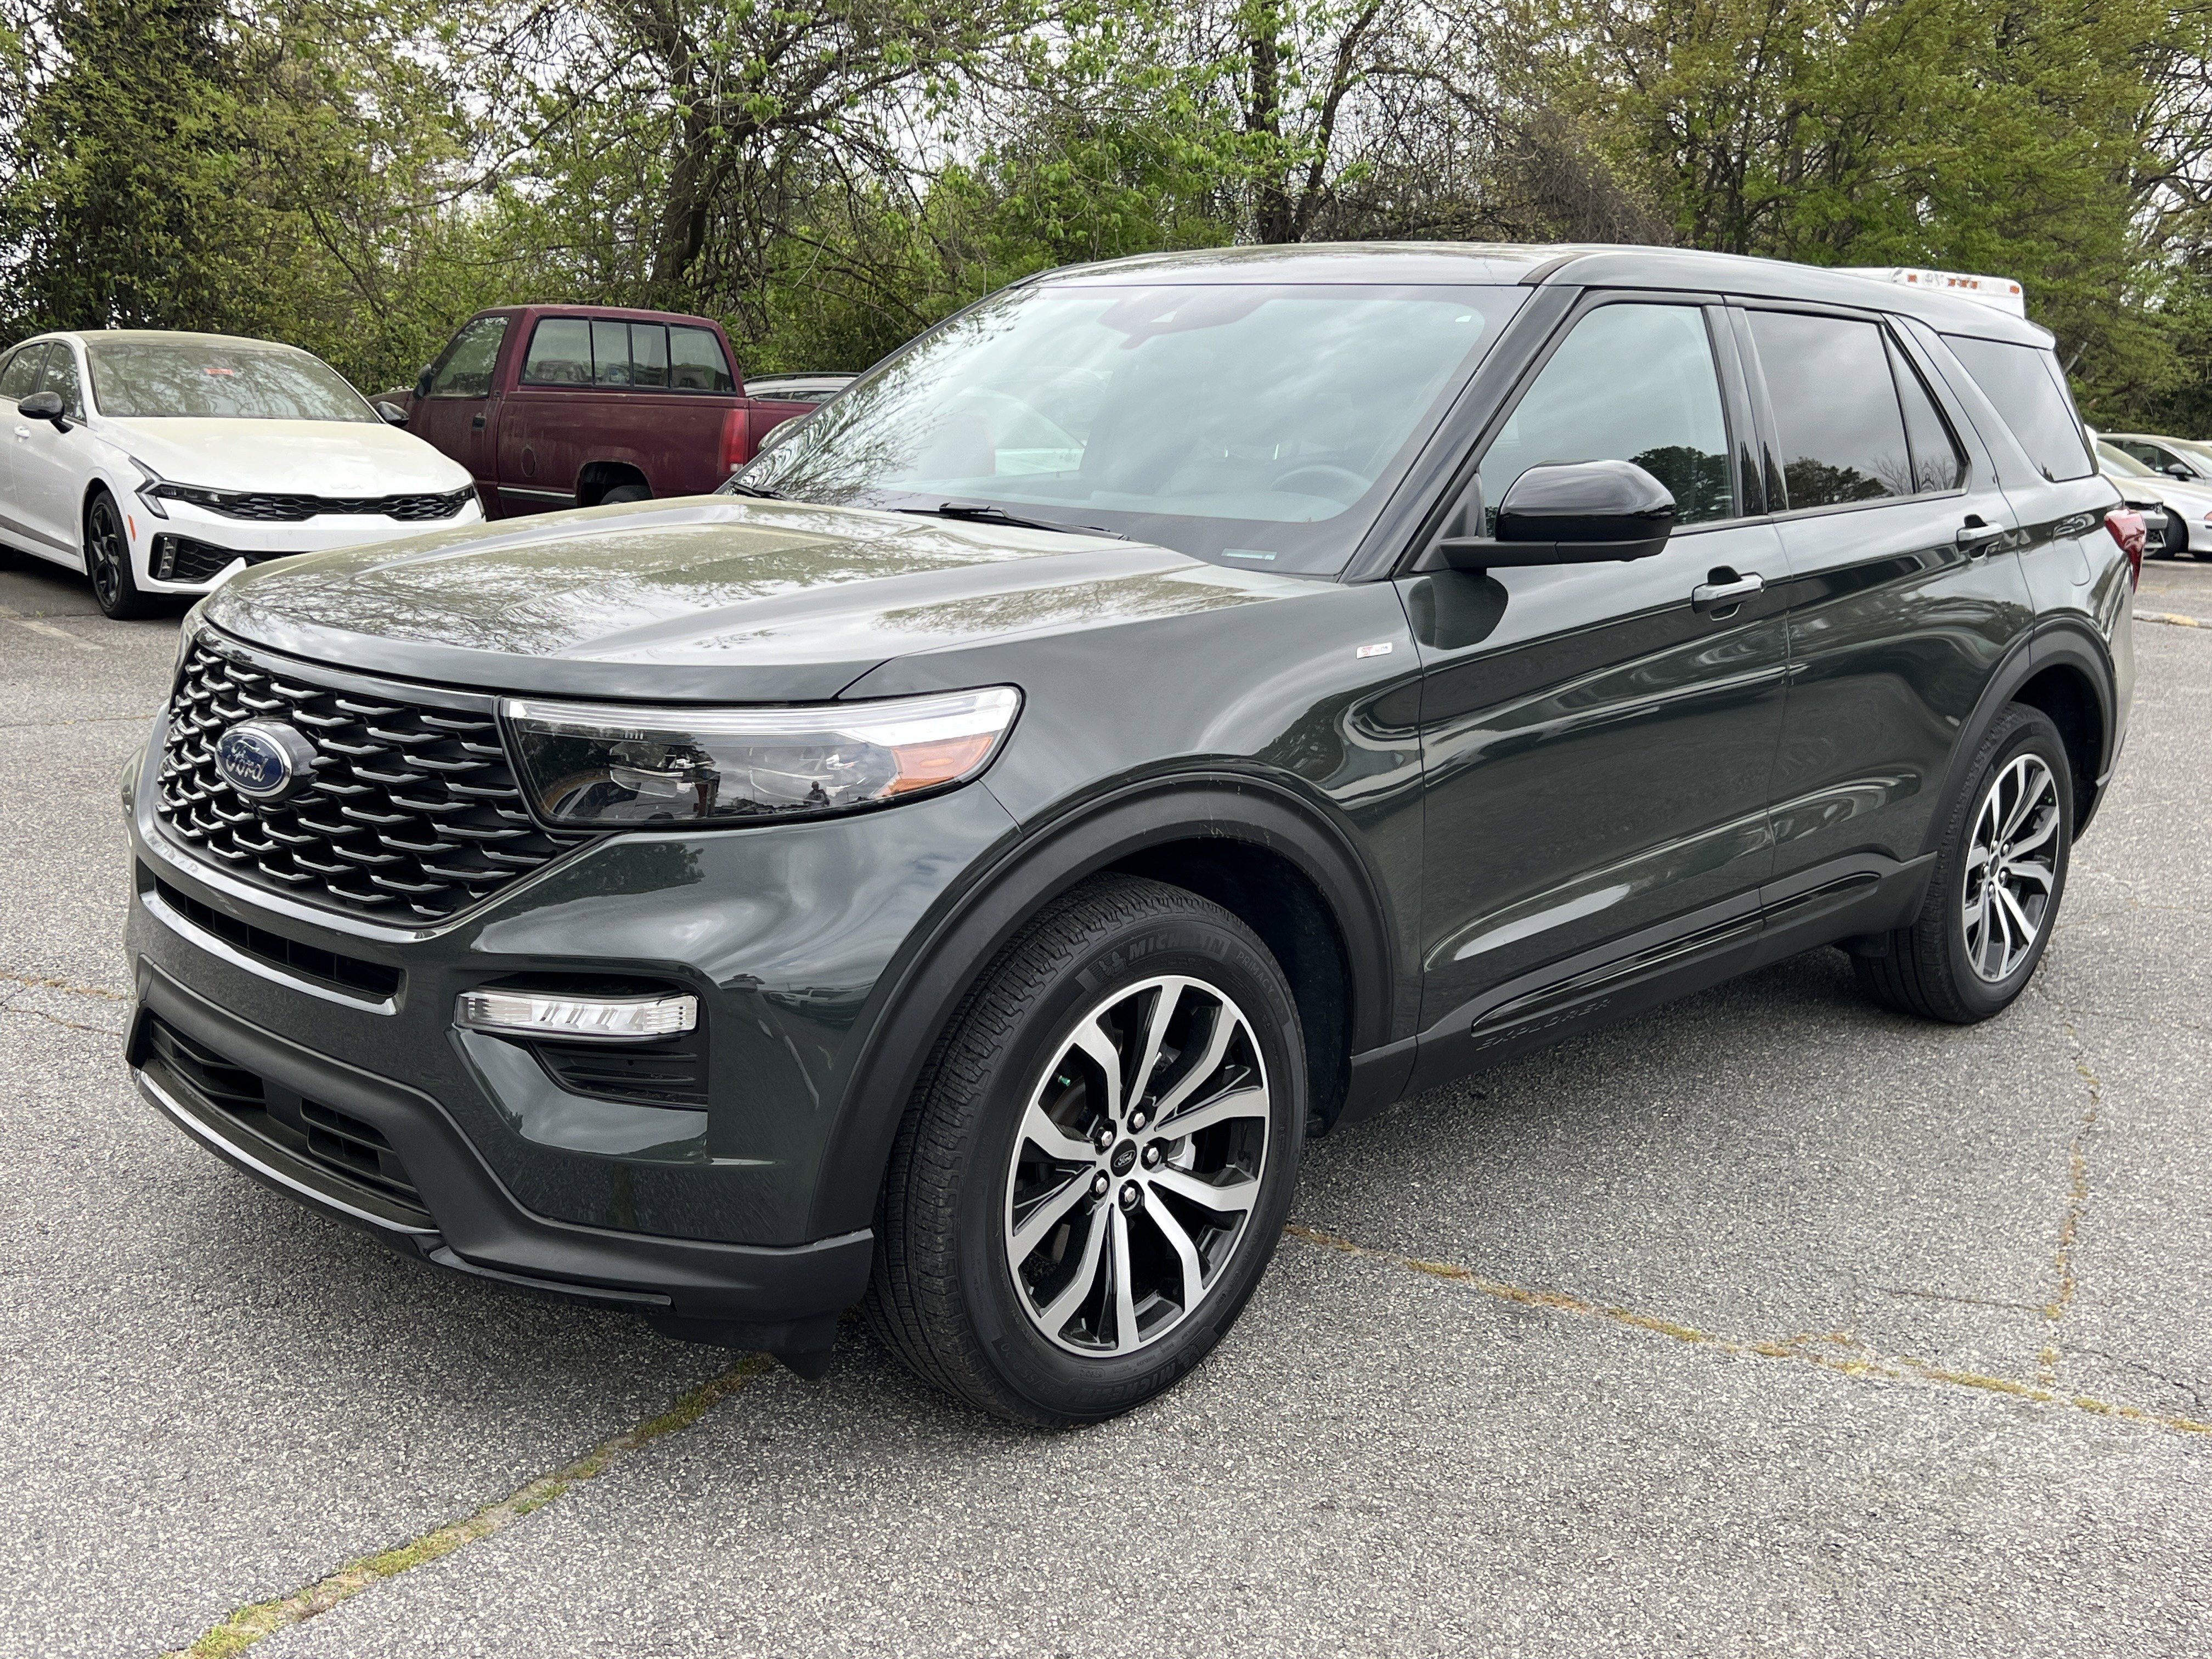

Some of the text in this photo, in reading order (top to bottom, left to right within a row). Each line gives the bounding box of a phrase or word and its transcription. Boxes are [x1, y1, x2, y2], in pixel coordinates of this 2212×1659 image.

[225, 740, 269, 782] Ford
[1128, 932, 1226, 961] MICHIN
[1237, 950, 1275, 994] PRIMACY
[1476, 996, 1613, 1052] EXPLORER
